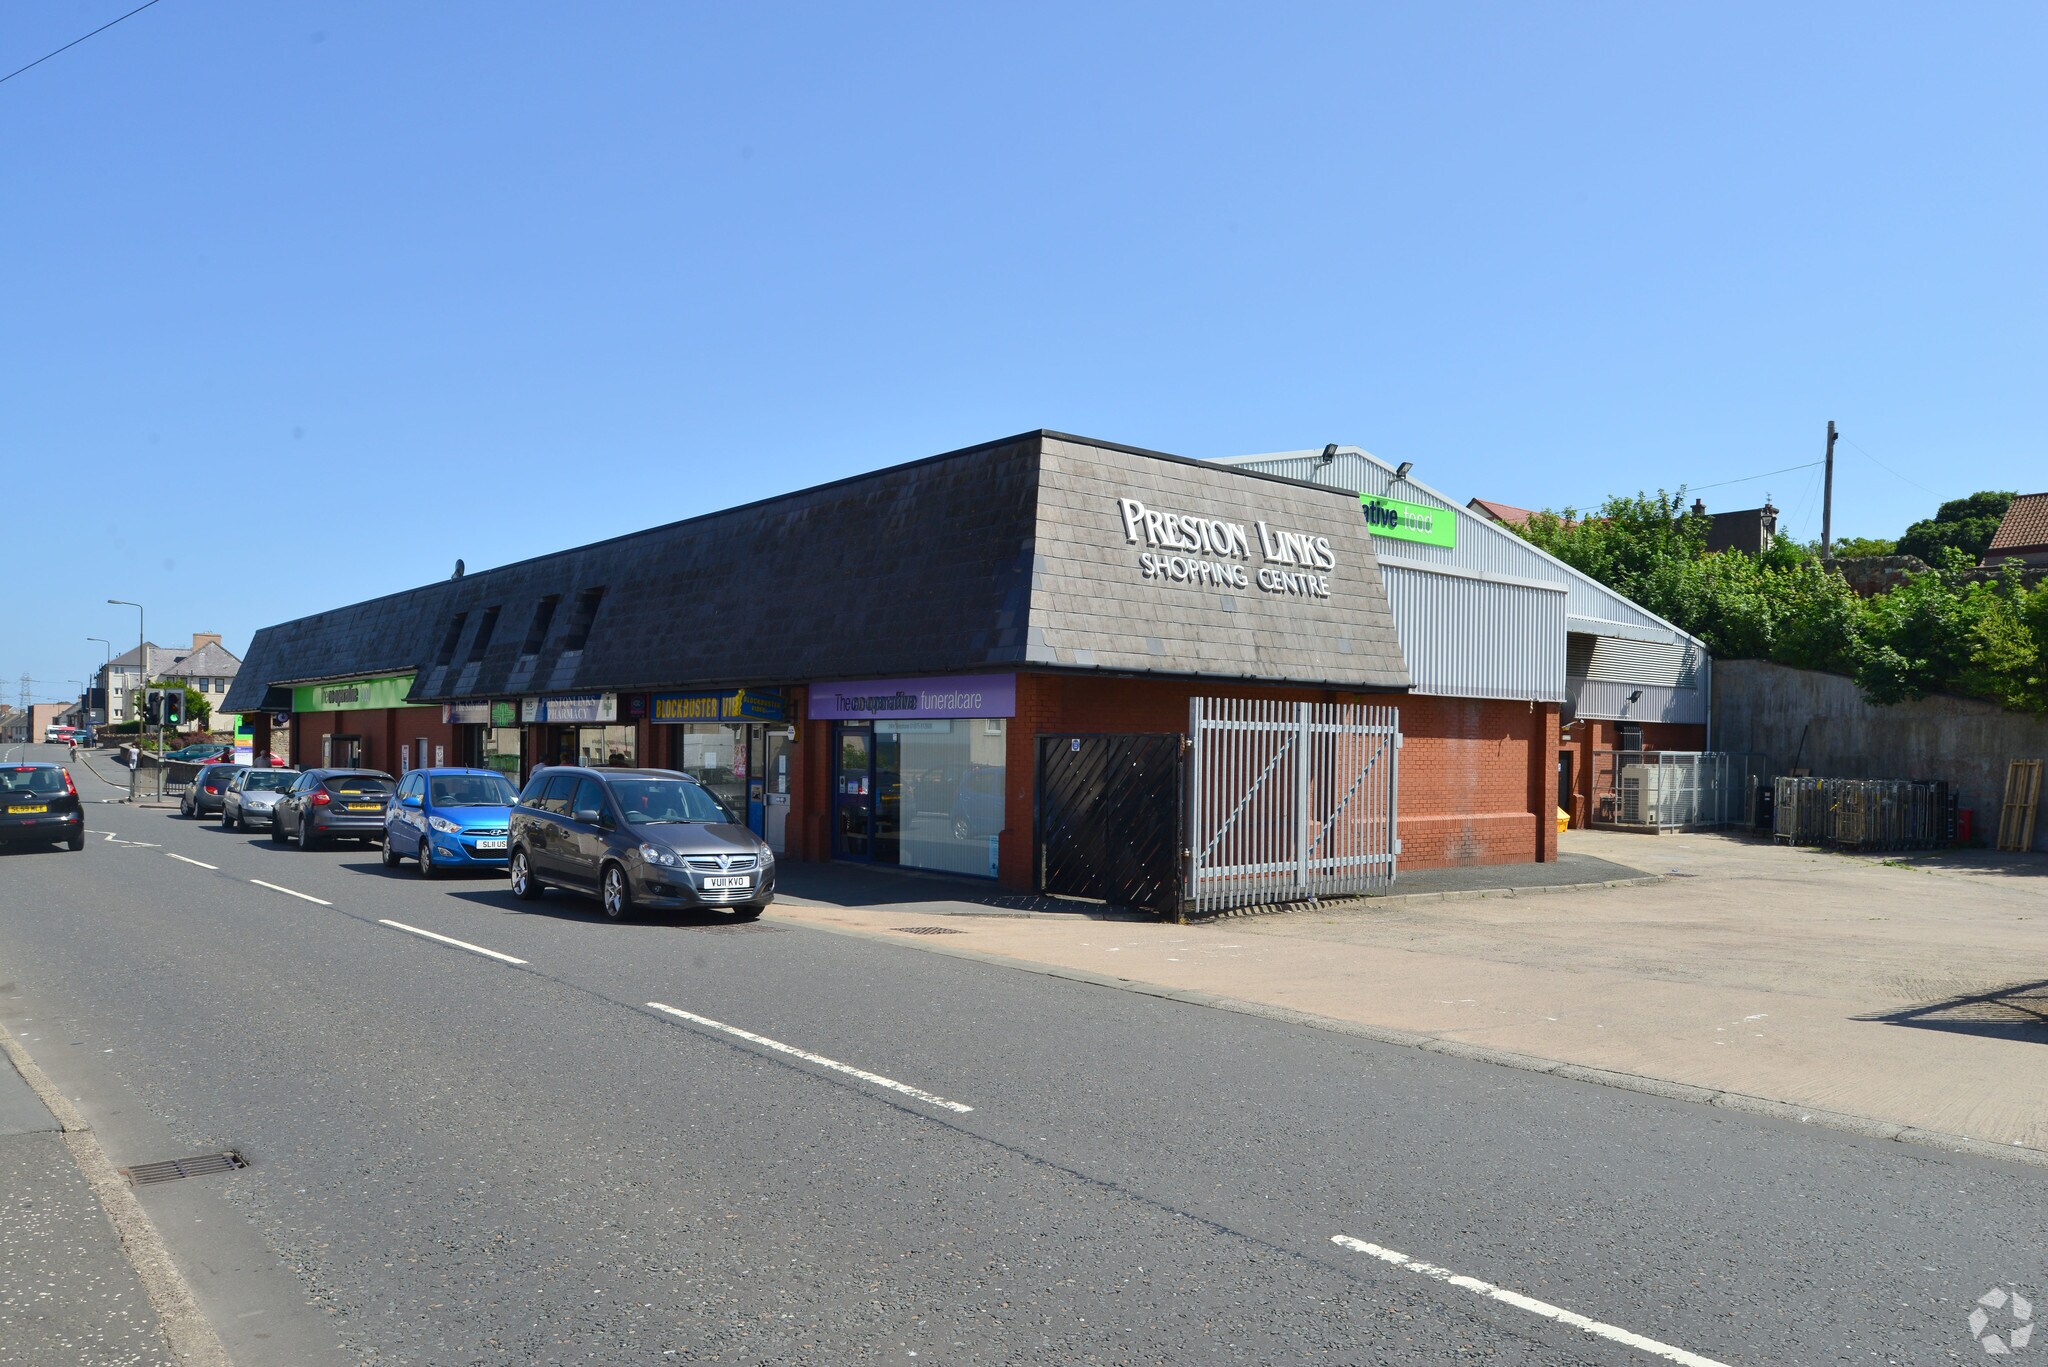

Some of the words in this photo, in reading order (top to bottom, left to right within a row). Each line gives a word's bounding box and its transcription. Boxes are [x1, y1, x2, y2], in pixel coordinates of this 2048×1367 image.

[1404, 507, 1432, 534] food
[1118, 498, 1251, 560] PRESTON
[1255, 520, 1336, 571] LINKS
[1139, 552, 1249, 588] SHOPPING
[1256, 568, 1331, 598] CENTRE
[656, 697, 717, 718] BLOCKBUSTER
[835, 693, 850, 711] The
[921, 690, 982, 711] funeralcare
[548, 708, 588, 720] PHARMACY
[711, 878, 727, 887] VU11
